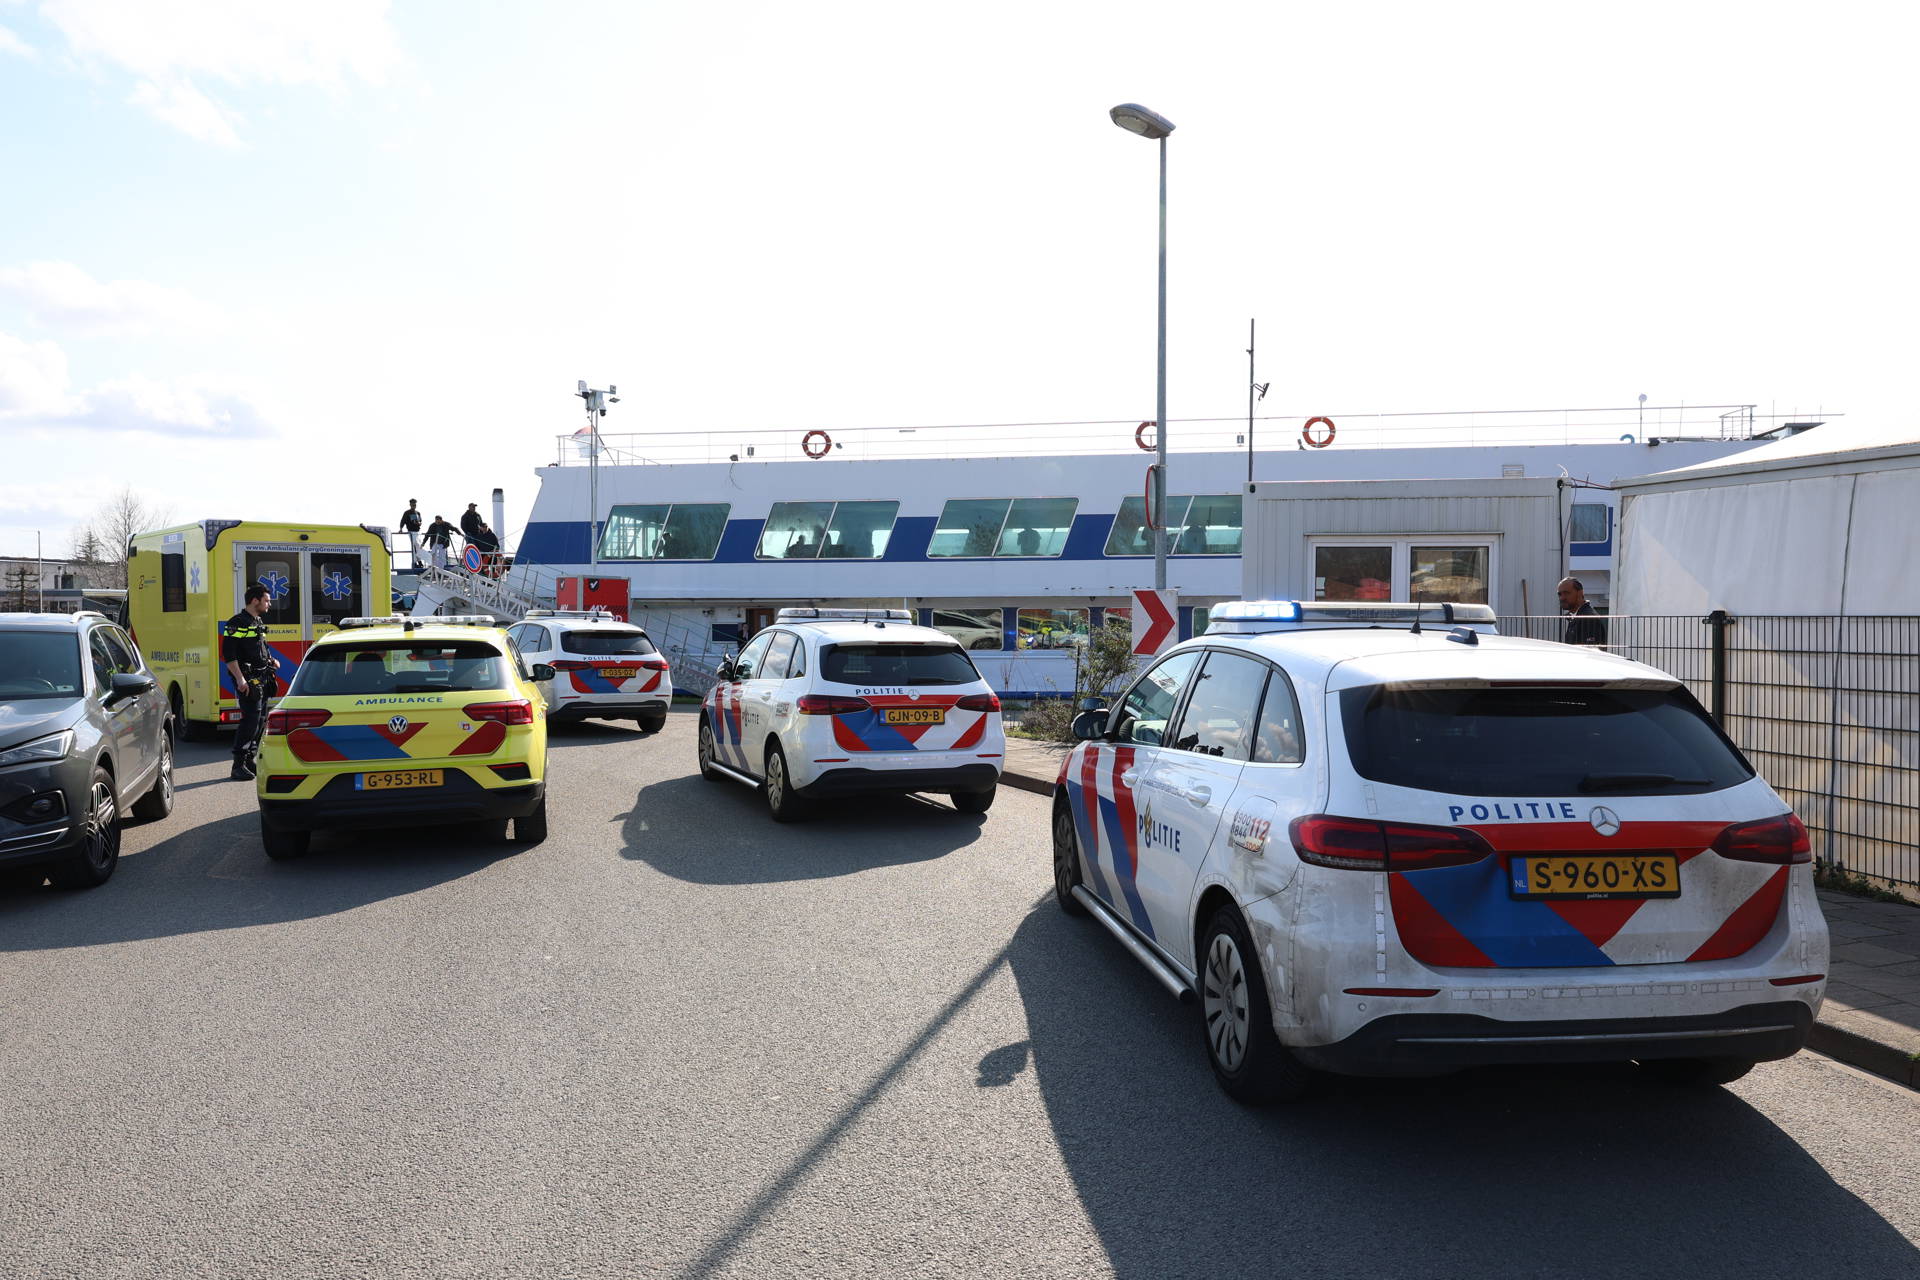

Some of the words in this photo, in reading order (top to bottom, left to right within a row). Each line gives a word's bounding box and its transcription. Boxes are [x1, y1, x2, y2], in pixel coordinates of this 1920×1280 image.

[151, 650, 179, 663] AMBULANCE
[855, 687, 904, 695] POLITIE
[355, 696, 443, 706] AMBULANCE
[888, 708, 941, 722] GJN-09-B
[368, 772, 438, 788] G-953-RL
[1449, 803, 1576, 822] POLITIE
[1139, 814, 1181, 853] POLITIE
[1515, 878, 1526, 888] NL
[1535, 861, 1667, 889] S-960-XS
